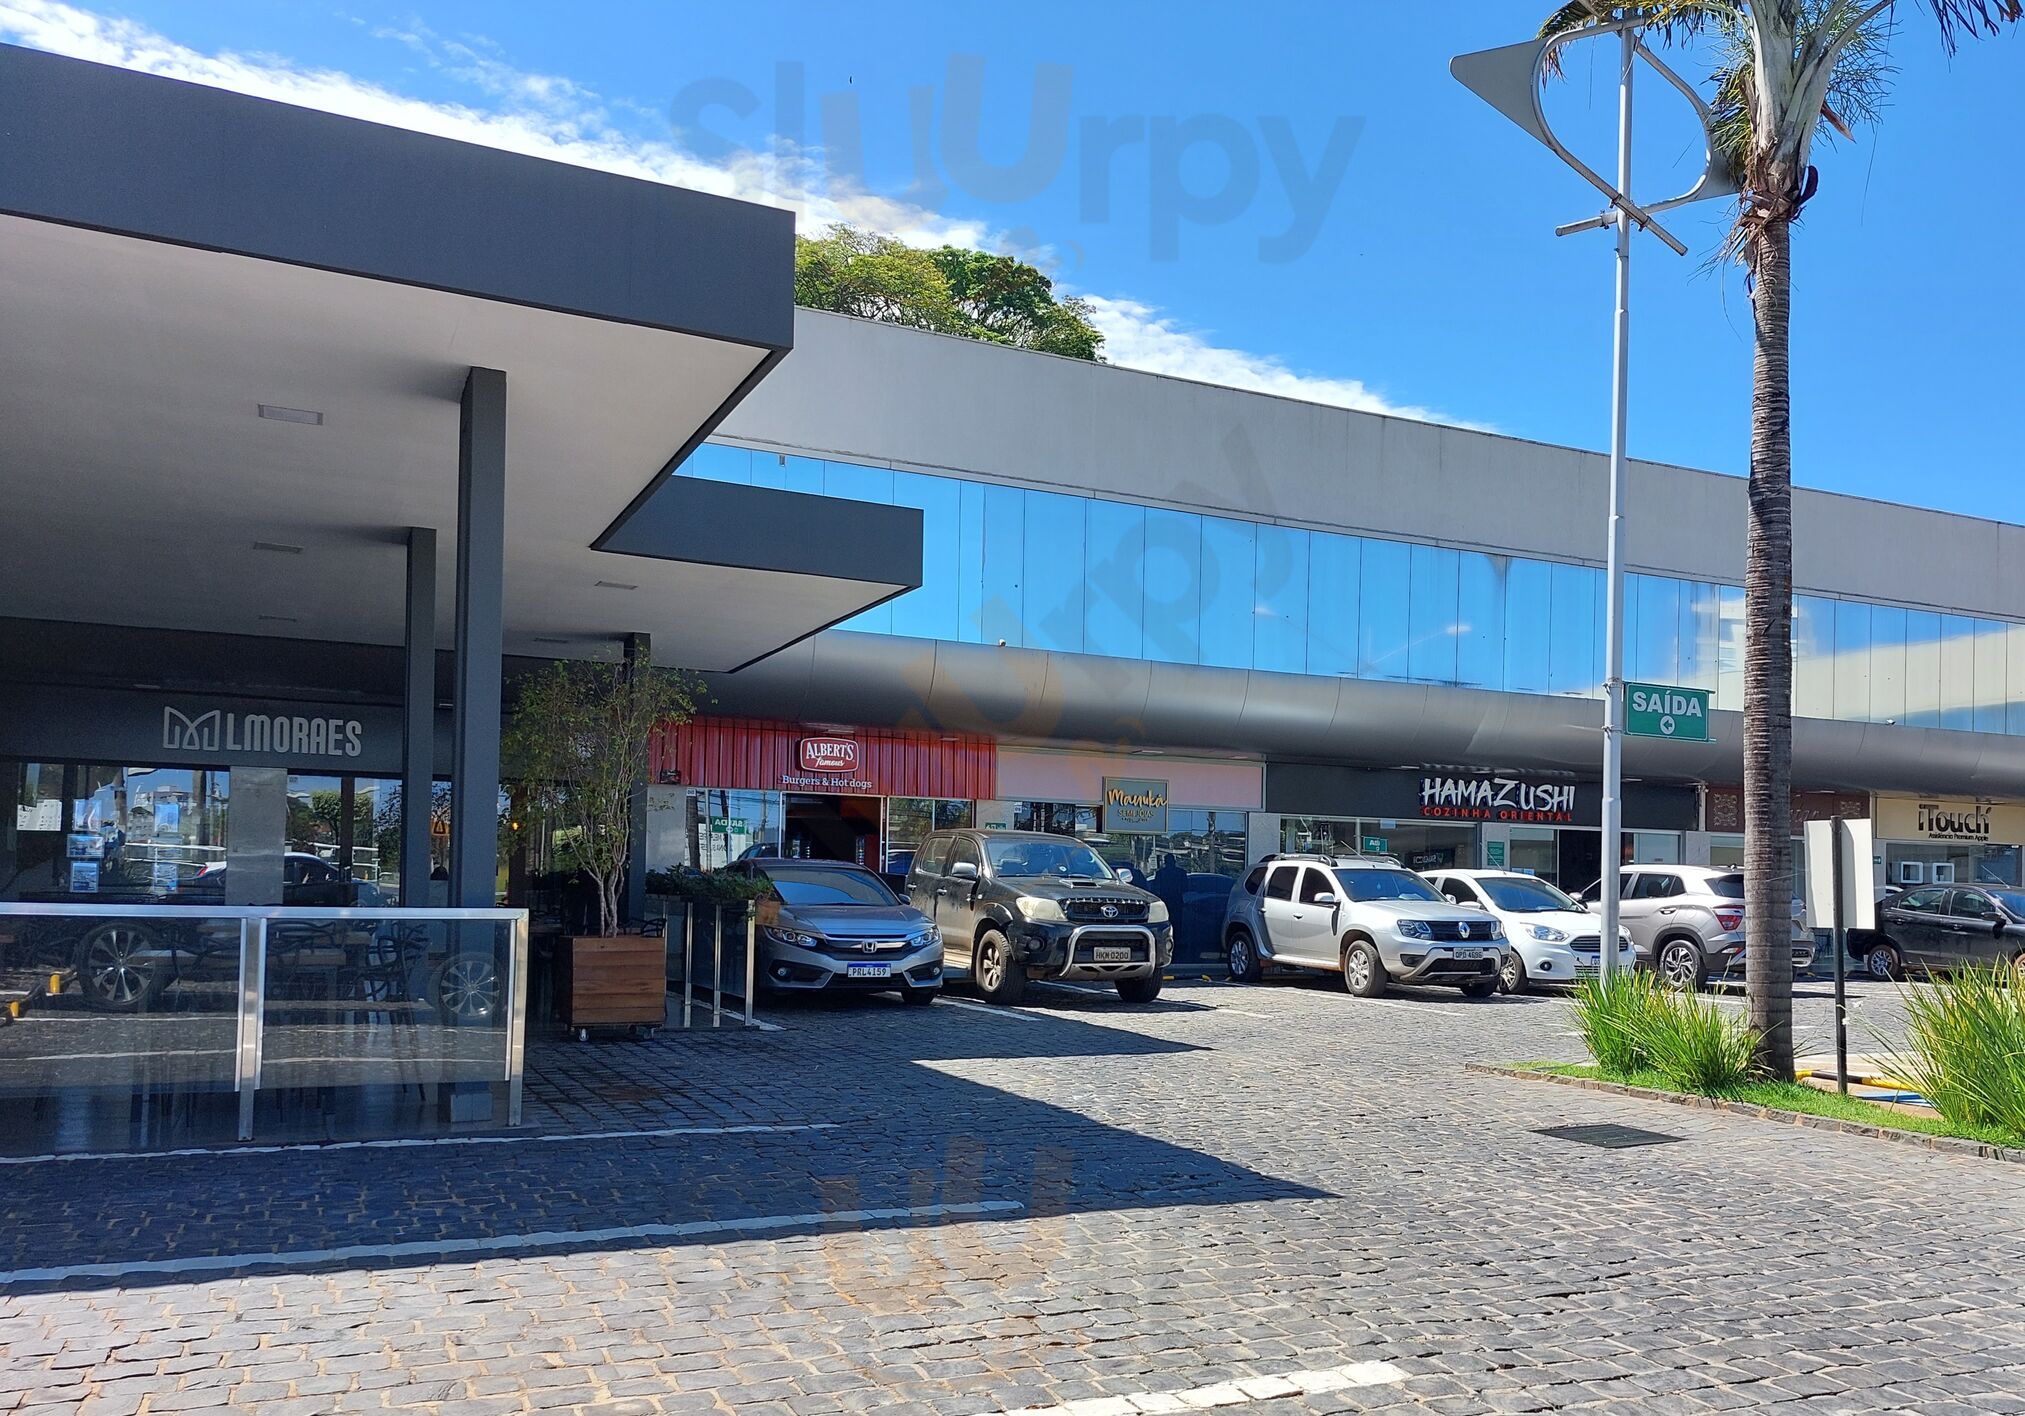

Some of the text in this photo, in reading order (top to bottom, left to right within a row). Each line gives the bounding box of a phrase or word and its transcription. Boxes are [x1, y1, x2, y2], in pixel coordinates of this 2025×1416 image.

[1632, 690, 1703, 718] SAÍDA
[806, 742, 854, 761] ALBERT'S
[814, 756, 845, 767] famous
[782, 775, 872, 789] Burgers & Hot dogs
[1421, 777, 1576, 812] HAMAZUSHI
[1422, 806, 1573, 822] COZINHA ORIENTAL
[1918, 804, 1992, 834] iTouch
